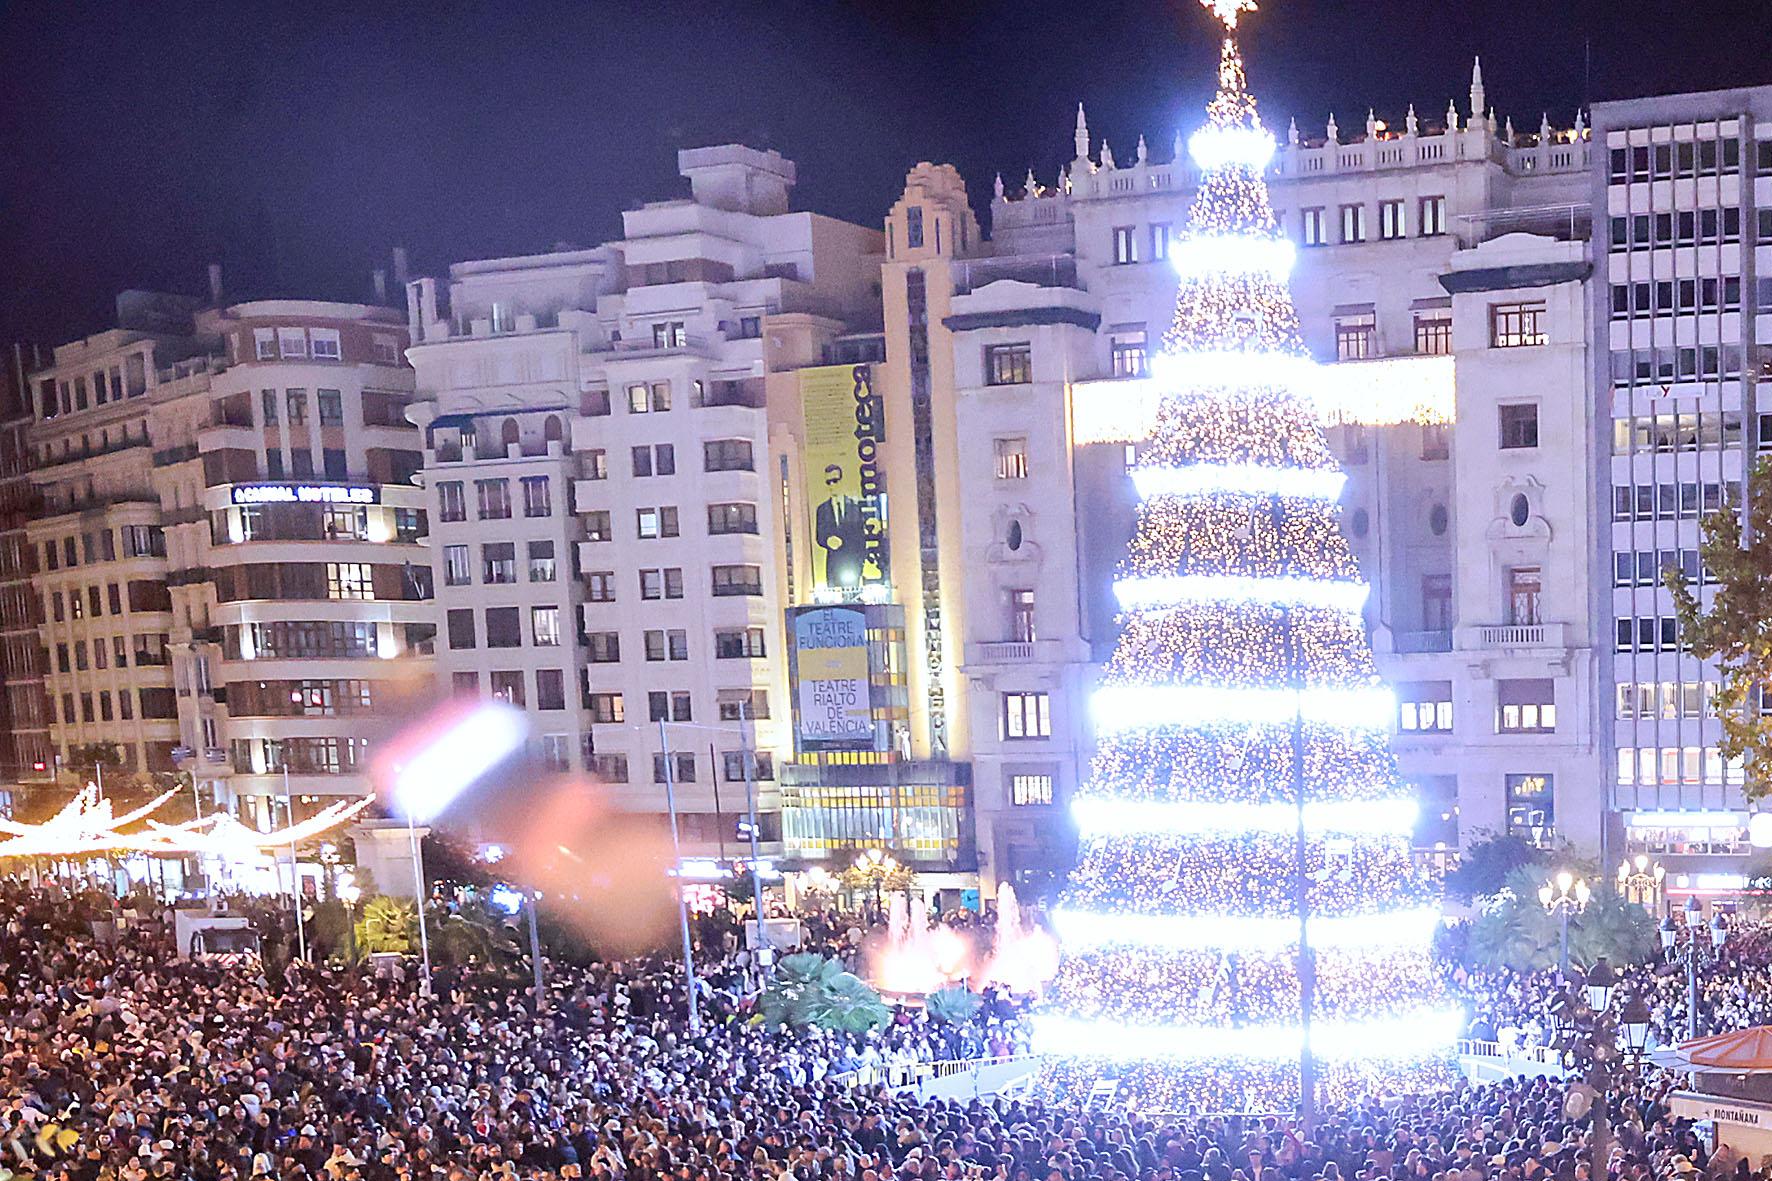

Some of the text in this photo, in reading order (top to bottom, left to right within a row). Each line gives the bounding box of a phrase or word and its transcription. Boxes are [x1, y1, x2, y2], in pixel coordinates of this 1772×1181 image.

[808, 620, 854, 635] TEATRE
[799, 634, 867, 650] FUNCIONA
[811, 678, 857, 692] TEATRE
[813, 692, 856, 706] RIALTO
[827, 706, 843, 719] DE
[1714, 1109, 1759, 1124] MONTAÑANA
